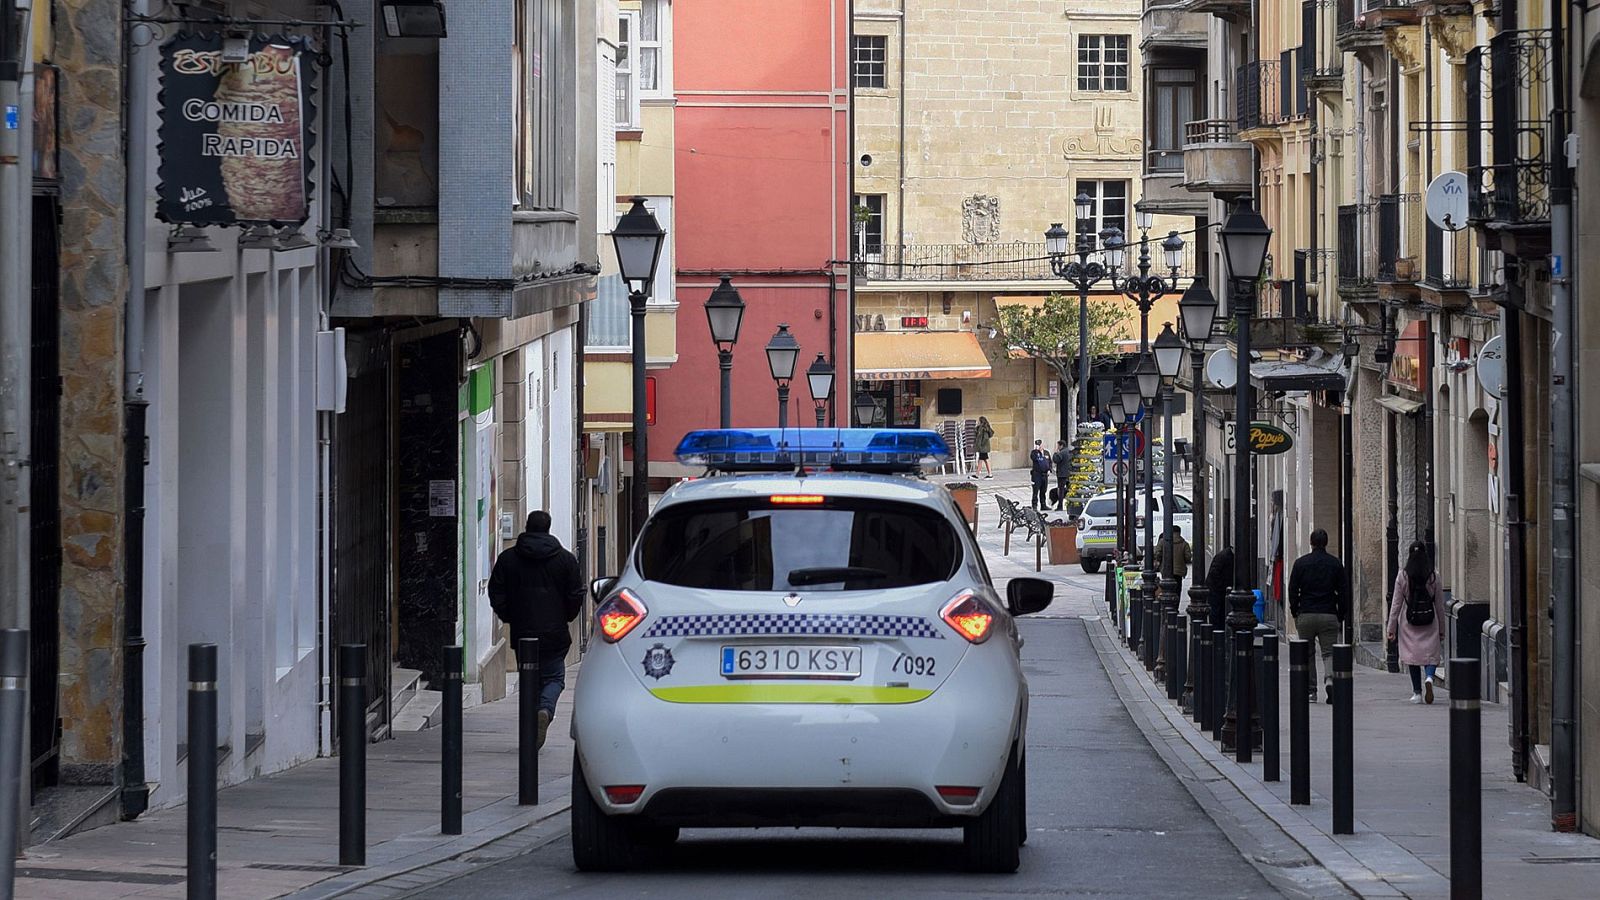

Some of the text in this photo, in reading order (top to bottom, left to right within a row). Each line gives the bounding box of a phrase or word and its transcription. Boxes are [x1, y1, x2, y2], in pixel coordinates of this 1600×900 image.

[183, 98, 283, 123] COMIDA
[202, 133, 297, 158] RAPIDA
[184, 198, 213, 212] 100%
[738, 649, 854, 671] 6310 KSY
